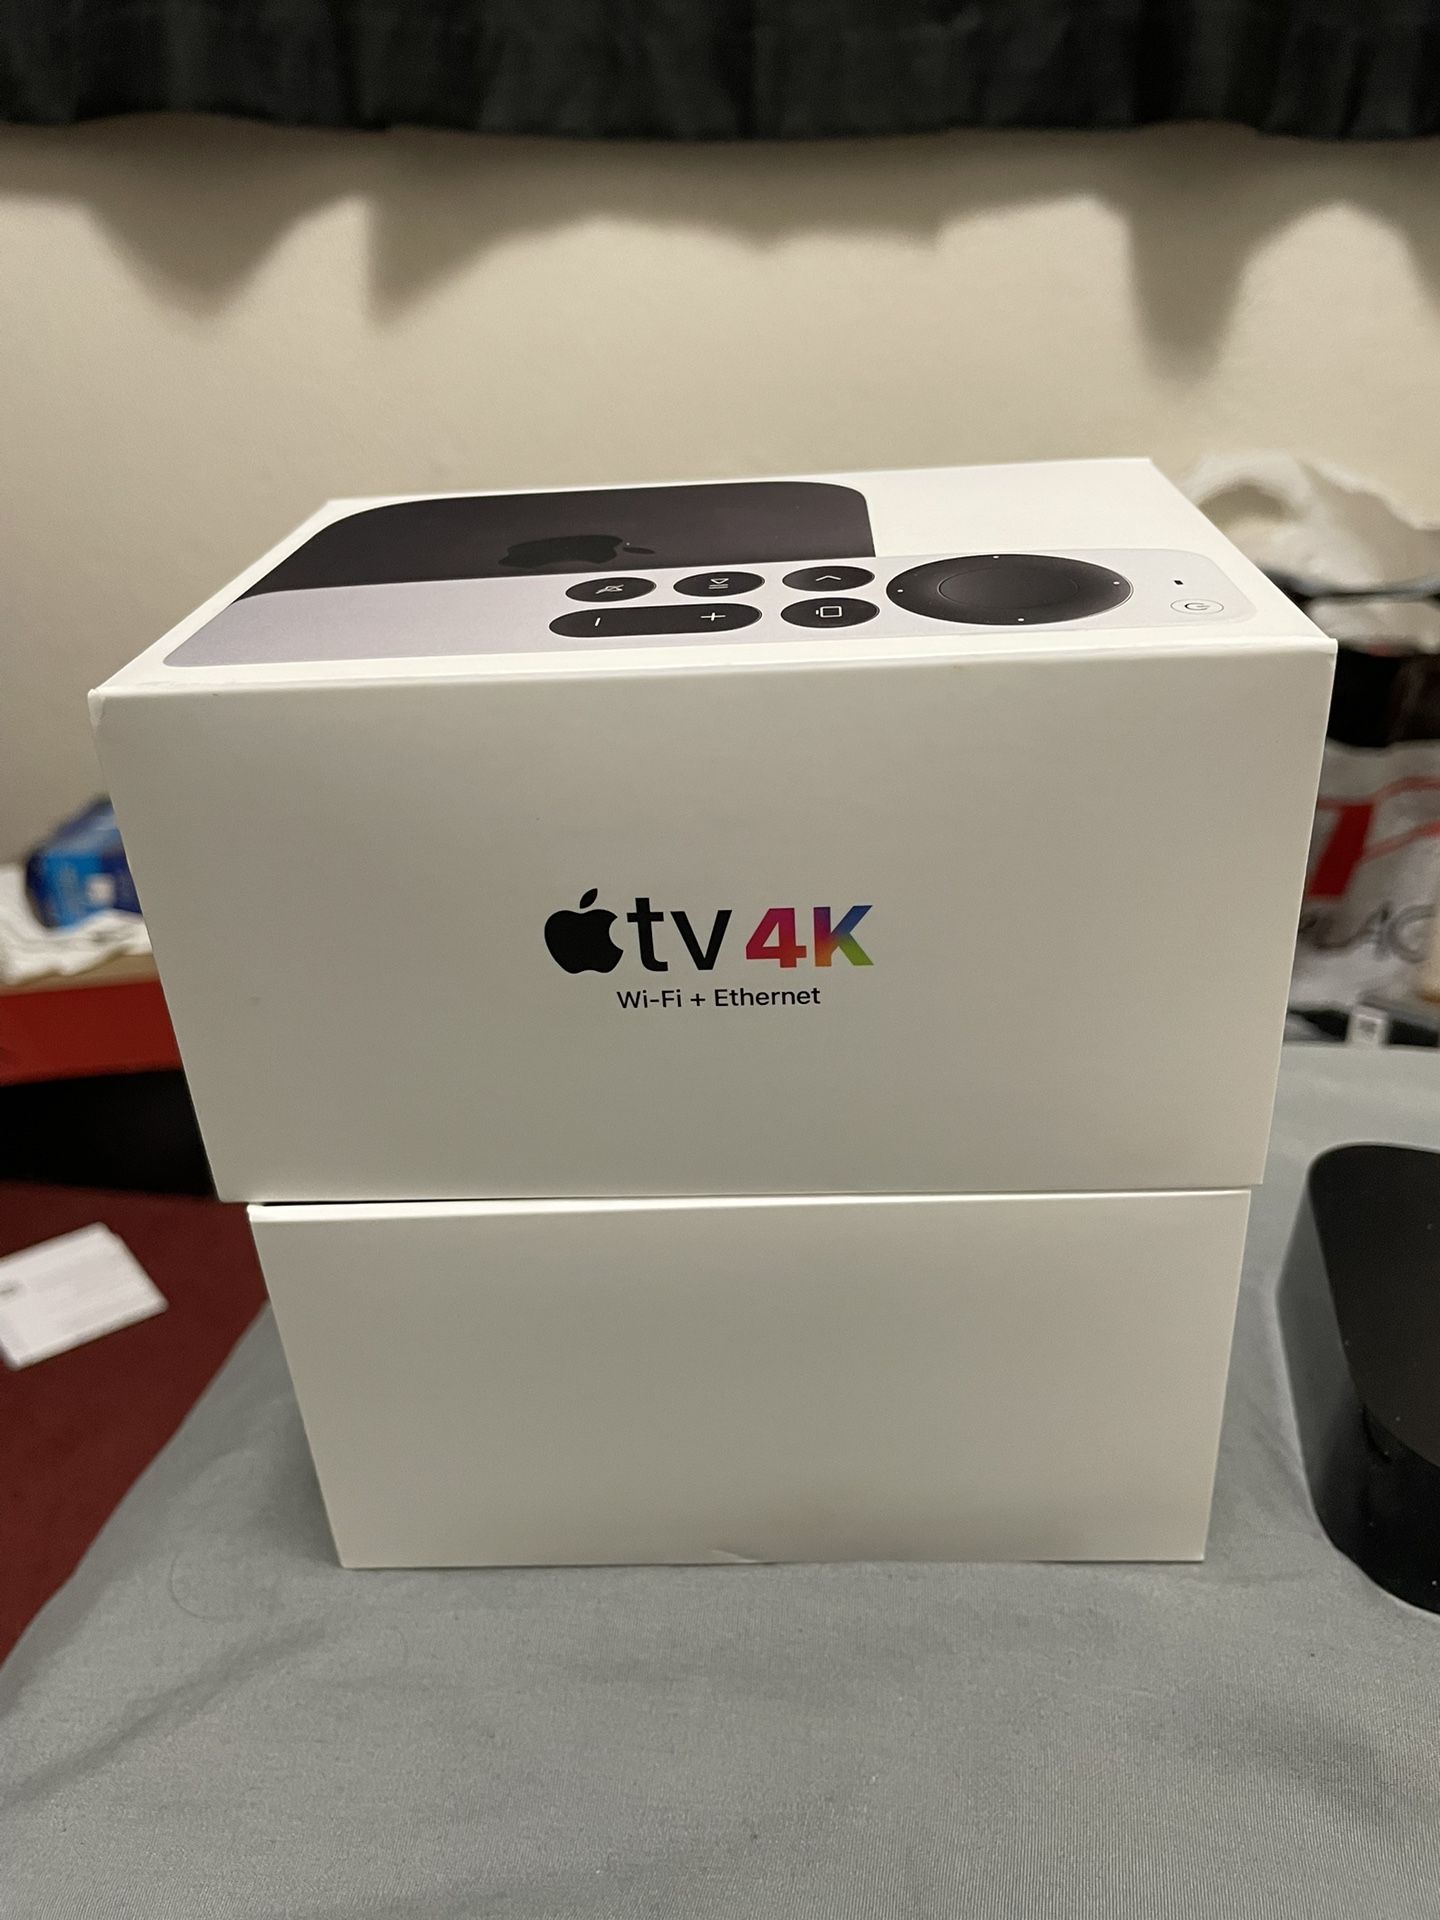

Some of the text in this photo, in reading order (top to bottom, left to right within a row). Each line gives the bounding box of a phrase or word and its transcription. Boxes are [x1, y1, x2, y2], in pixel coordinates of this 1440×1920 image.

[627, 897, 875, 972] tv 4K
[616, 989, 682, 1009] Wi-Fi
[714, 987, 821, 1007] Ethernet
